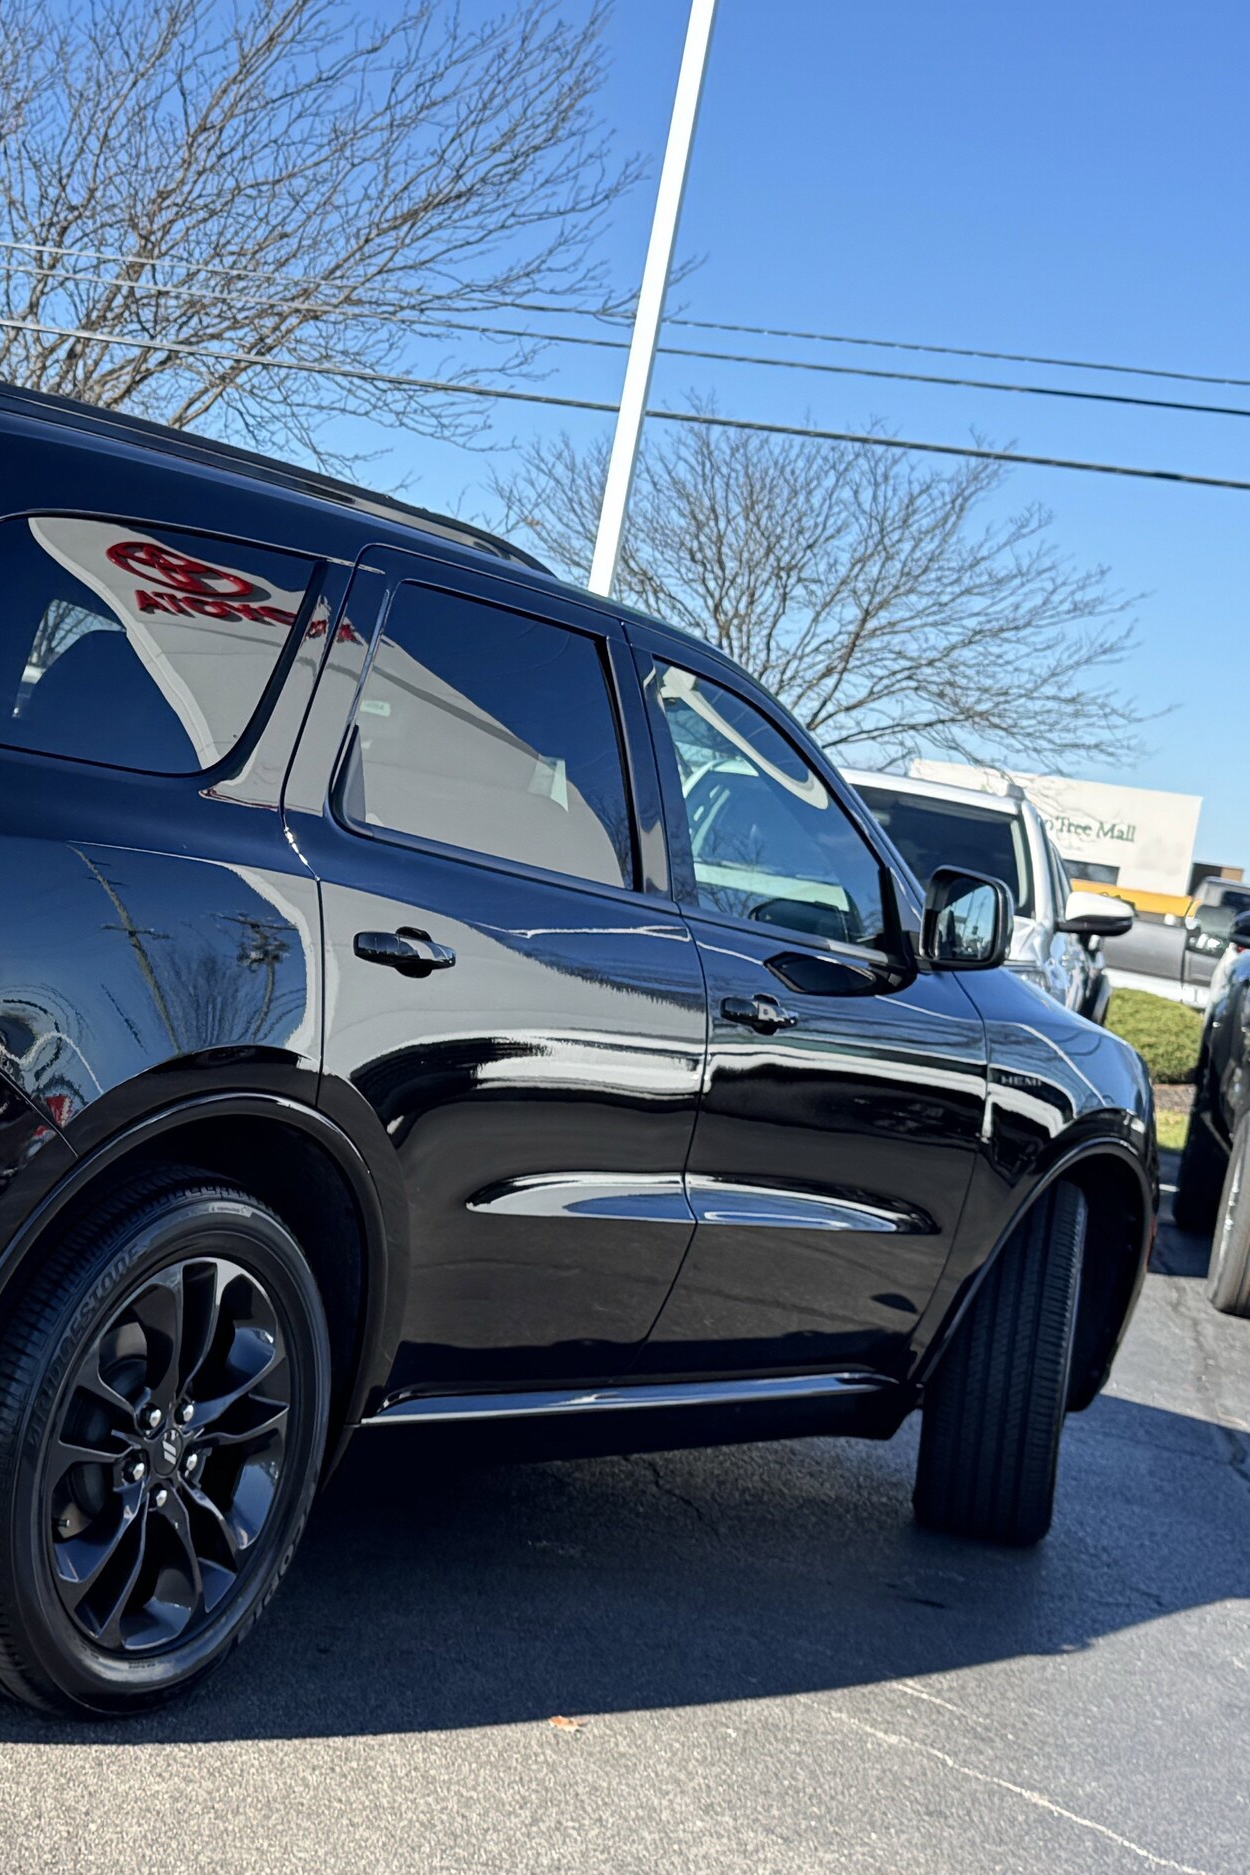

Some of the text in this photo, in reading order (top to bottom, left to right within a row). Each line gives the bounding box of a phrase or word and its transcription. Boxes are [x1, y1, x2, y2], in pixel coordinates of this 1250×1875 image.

[1055, 816, 1092, 837] Tree
[1096, 821, 1136, 842] Mall
[1000, 1074, 1042, 1087] HEMI
